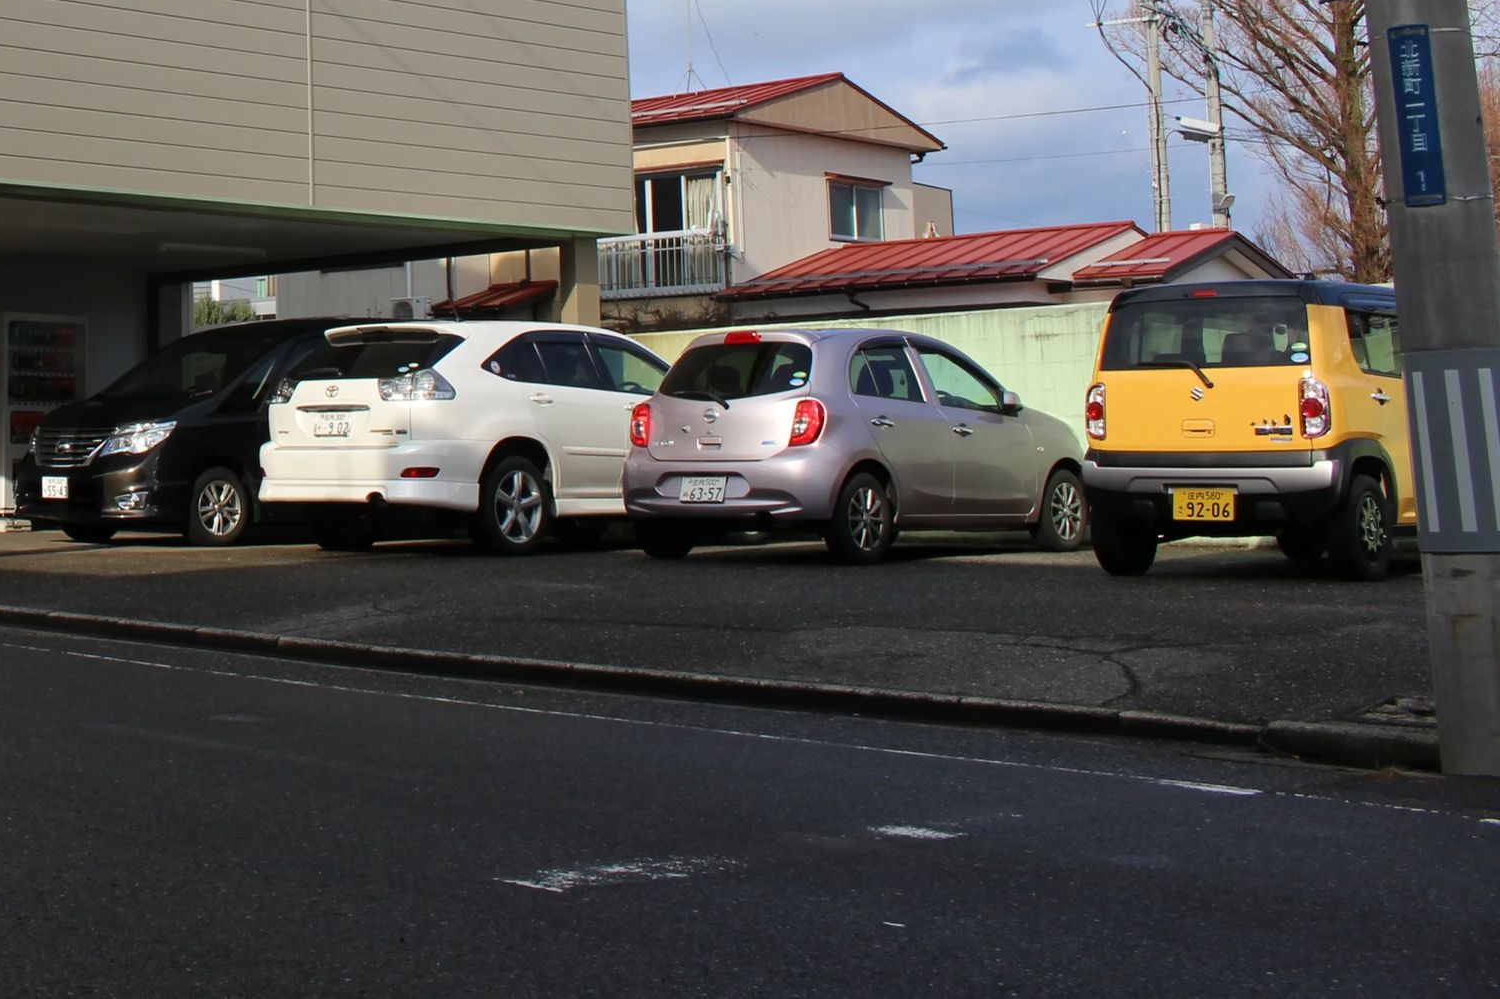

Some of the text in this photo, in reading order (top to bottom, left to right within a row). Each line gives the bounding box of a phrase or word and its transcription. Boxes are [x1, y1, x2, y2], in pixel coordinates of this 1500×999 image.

[689, 487, 722, 500] 63-57
[1187, 491, 1221, 500] 庄内580
[1186, 502, 1231, 518] 92-06
